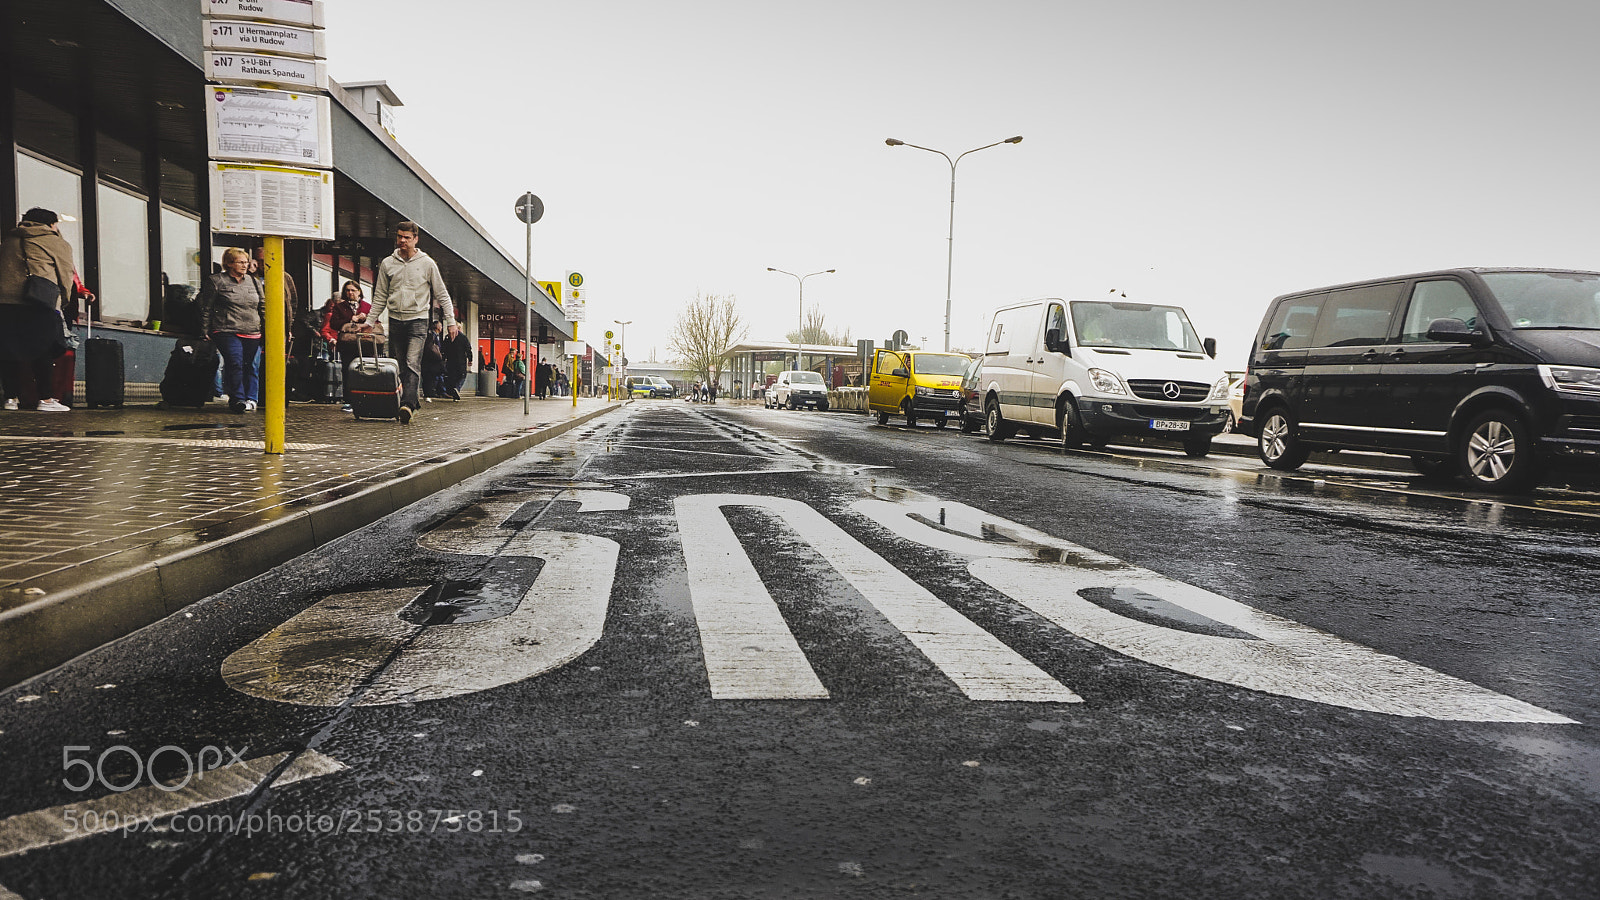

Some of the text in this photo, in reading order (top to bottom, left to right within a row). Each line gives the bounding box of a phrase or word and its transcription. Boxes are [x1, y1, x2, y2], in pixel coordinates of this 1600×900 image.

[238, 4, 263, 12] Rudow
[219, 26, 298, 40] 171 U Hermannplatz
[260, 37, 285, 46] Rudow
[220, 57, 271, 67] N7 S+U-Bhf
[241, 66, 305, 79] Rathaus Spandau
